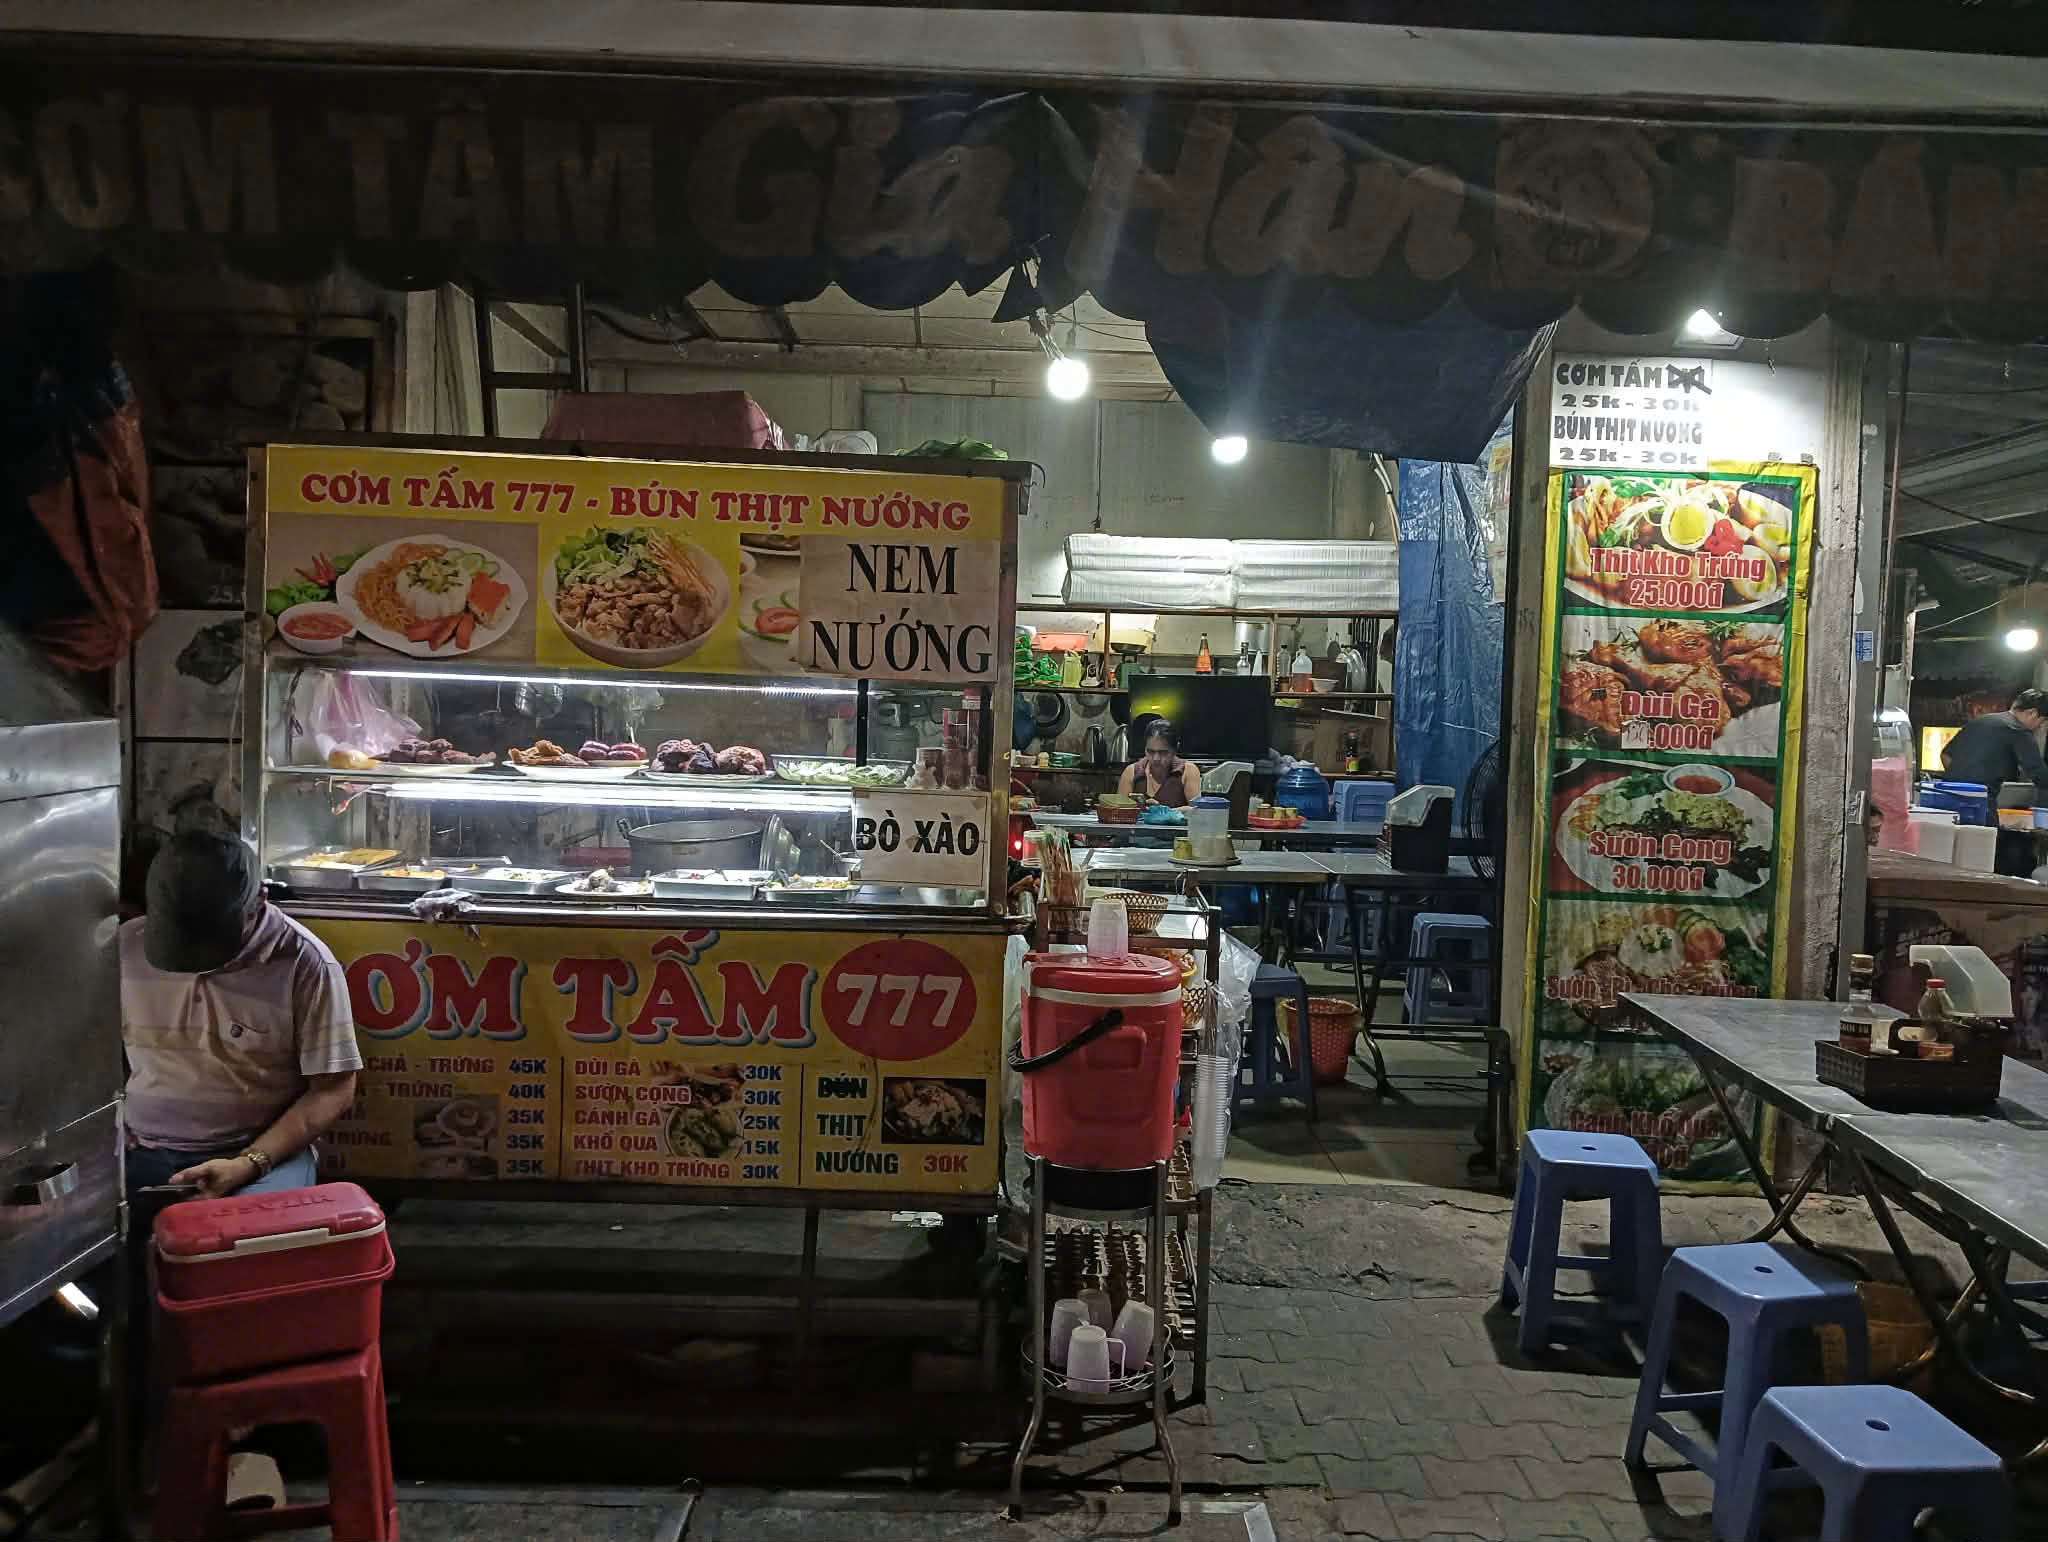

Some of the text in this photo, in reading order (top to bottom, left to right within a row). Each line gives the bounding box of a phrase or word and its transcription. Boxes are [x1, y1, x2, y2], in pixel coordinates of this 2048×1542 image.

[1557, 363, 1606, 387] CƠM
[1611, 358, 1662, 389] TẤM
[1554, 411, 1591, 440] BÚN
[1595, 416, 1637, 446] THỊT
[301, 470, 391, 506] CƠM
[404, 466, 495, 510] TẤM
[508, 482, 574, 514] 777
[609, 480, 699, 520] BÚN
[711, 490, 809, 531] THỊT
[822, 490, 971, 530] NƯỚNG
[846, 543, 960, 596] NEM
[1591, 548, 1768, 582] Thịt Kho Trứng
[1629, 578, 1725, 609] 25.000đ
[808, 608, 993, 674] NƯỚNG
[1619, 690, 1721, 720] Đùi Gà
[856, 810, 980, 856] BÒ XÀO
[1588, 830, 1732, 865] Sườn Cọng
[1612, 864, 1706, 892] 30.000đ
[552, 929, 818, 1047] TẤM
[837, 973, 963, 1027] 777
[508, 1058, 547, 1074] 45K
[615, 1058, 641, 1076] GÀ
[744, 1065, 782, 1081] 30K
[507, 1083, 546, 1099] 40K
[635, 1086, 691, 1105] CỌNG
[744, 1090, 782, 1106] 30K
[507, 1109, 545, 1124] 35K
[575, 1106, 630, 1126] CÁNH
[743, 1115, 781, 1130] 25K
[816, 1114, 867, 1141] THỊT
[506, 1134, 545, 1149] 35K
[619, 1135, 658, 1152] QUA
[744, 1140, 780, 1155] 15K
[506, 1159, 544, 1174] 35K
[621, 1160, 659, 1178] KHO
[665, 1158, 729, 1179] TRỨNG
[742, 1164, 780, 1179] 30K
[815, 1147, 968, 1174] NƯỚNG 30K
